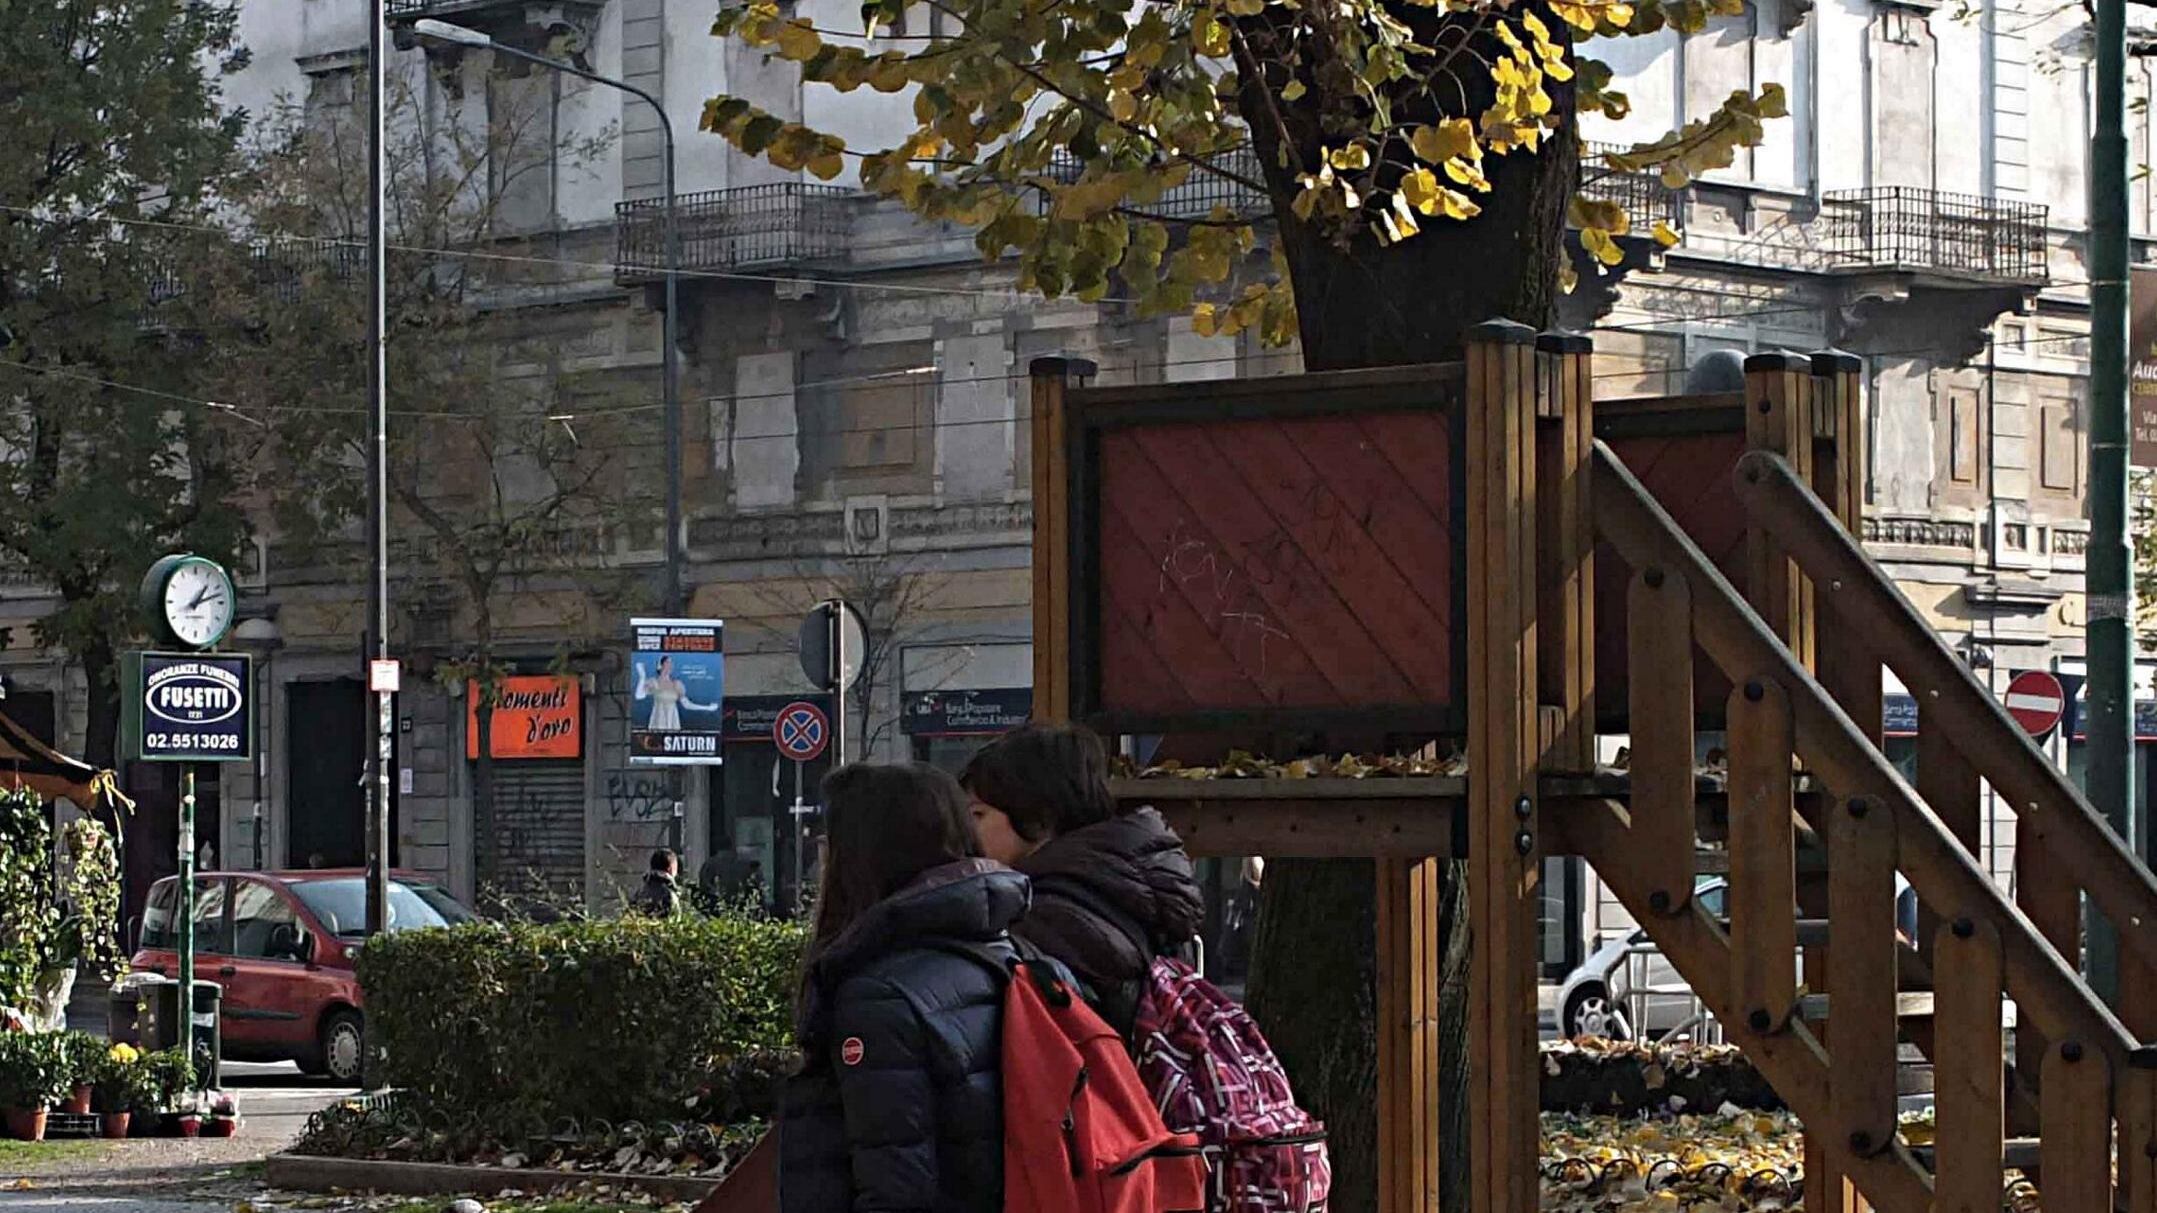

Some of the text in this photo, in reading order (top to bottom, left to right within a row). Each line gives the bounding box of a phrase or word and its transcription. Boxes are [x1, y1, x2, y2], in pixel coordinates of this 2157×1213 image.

[160, 686, 229, 709] FUSETTI
[146, 733, 239, 750] 02.5513026
[664, 735, 716, 752] SATURN
